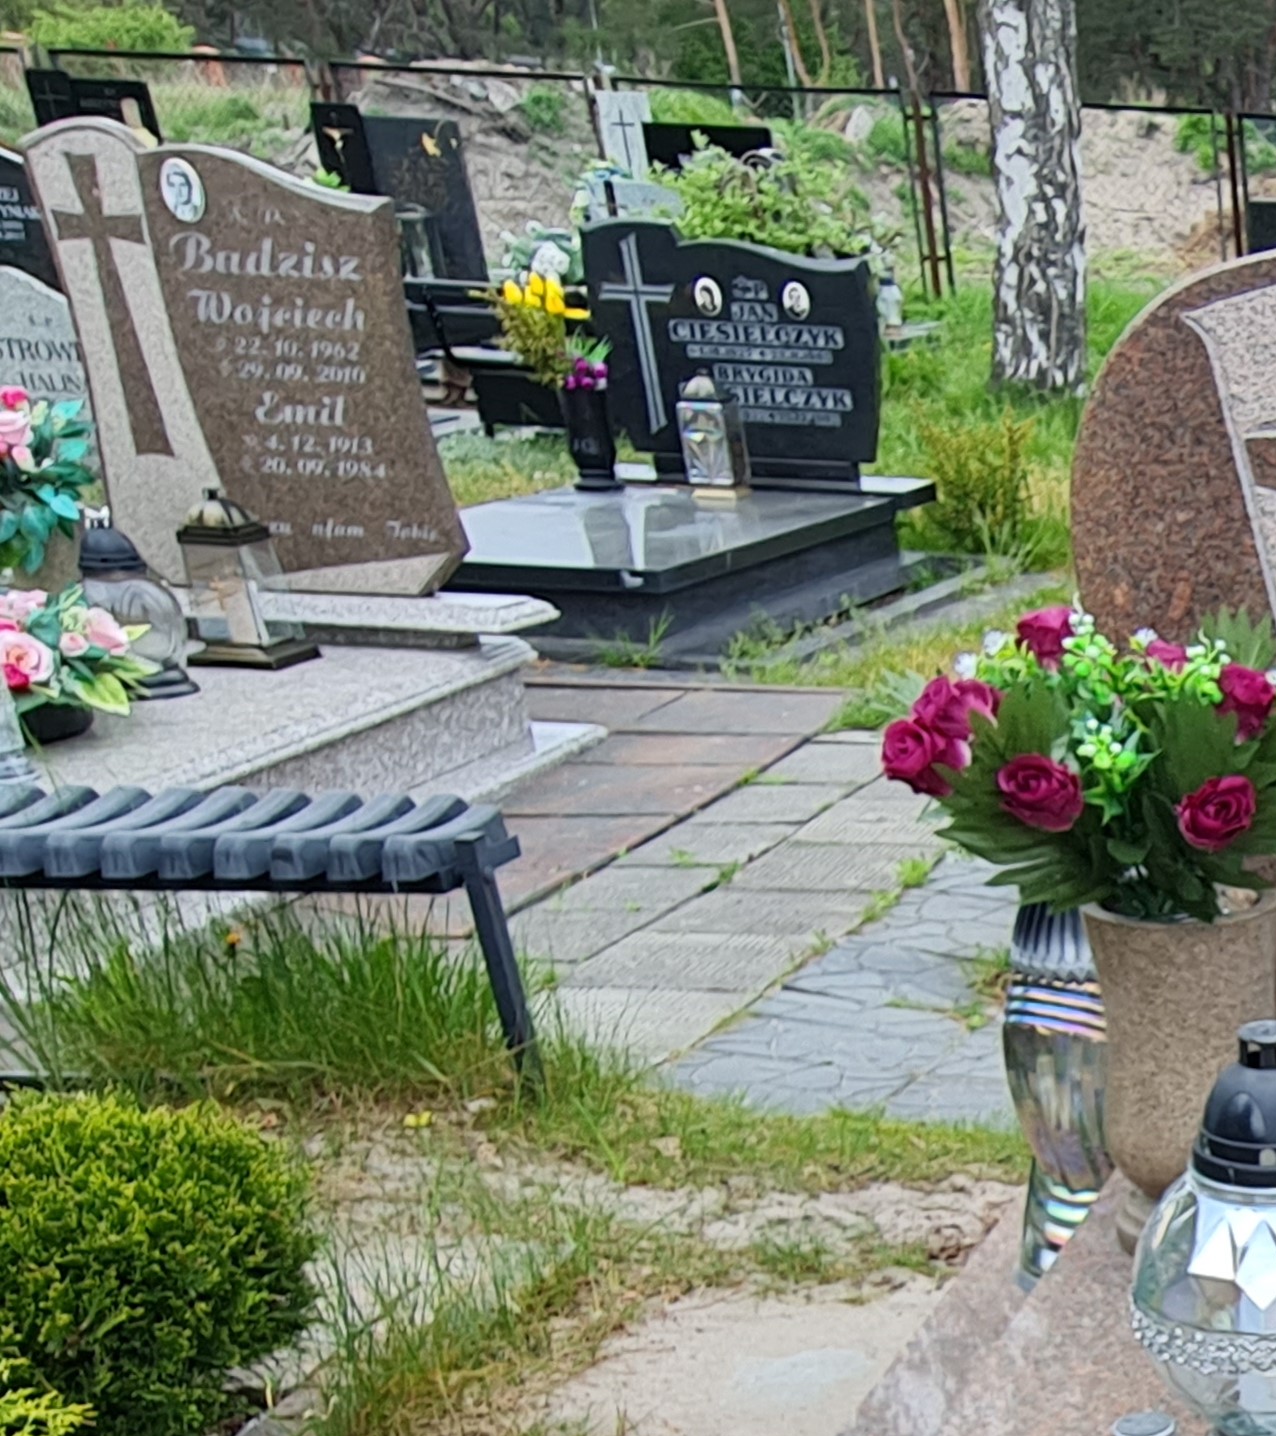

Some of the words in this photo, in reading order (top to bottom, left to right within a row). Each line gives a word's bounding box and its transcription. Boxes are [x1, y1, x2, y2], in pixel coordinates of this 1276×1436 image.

[169, 231, 364, 282] Badzisz
[187, 288, 366, 334] Wojciech
[733, 303, 774, 321] JAN
[717, 364, 809, 384] BRYGIDA
[255, 391, 346, 427] Emil
